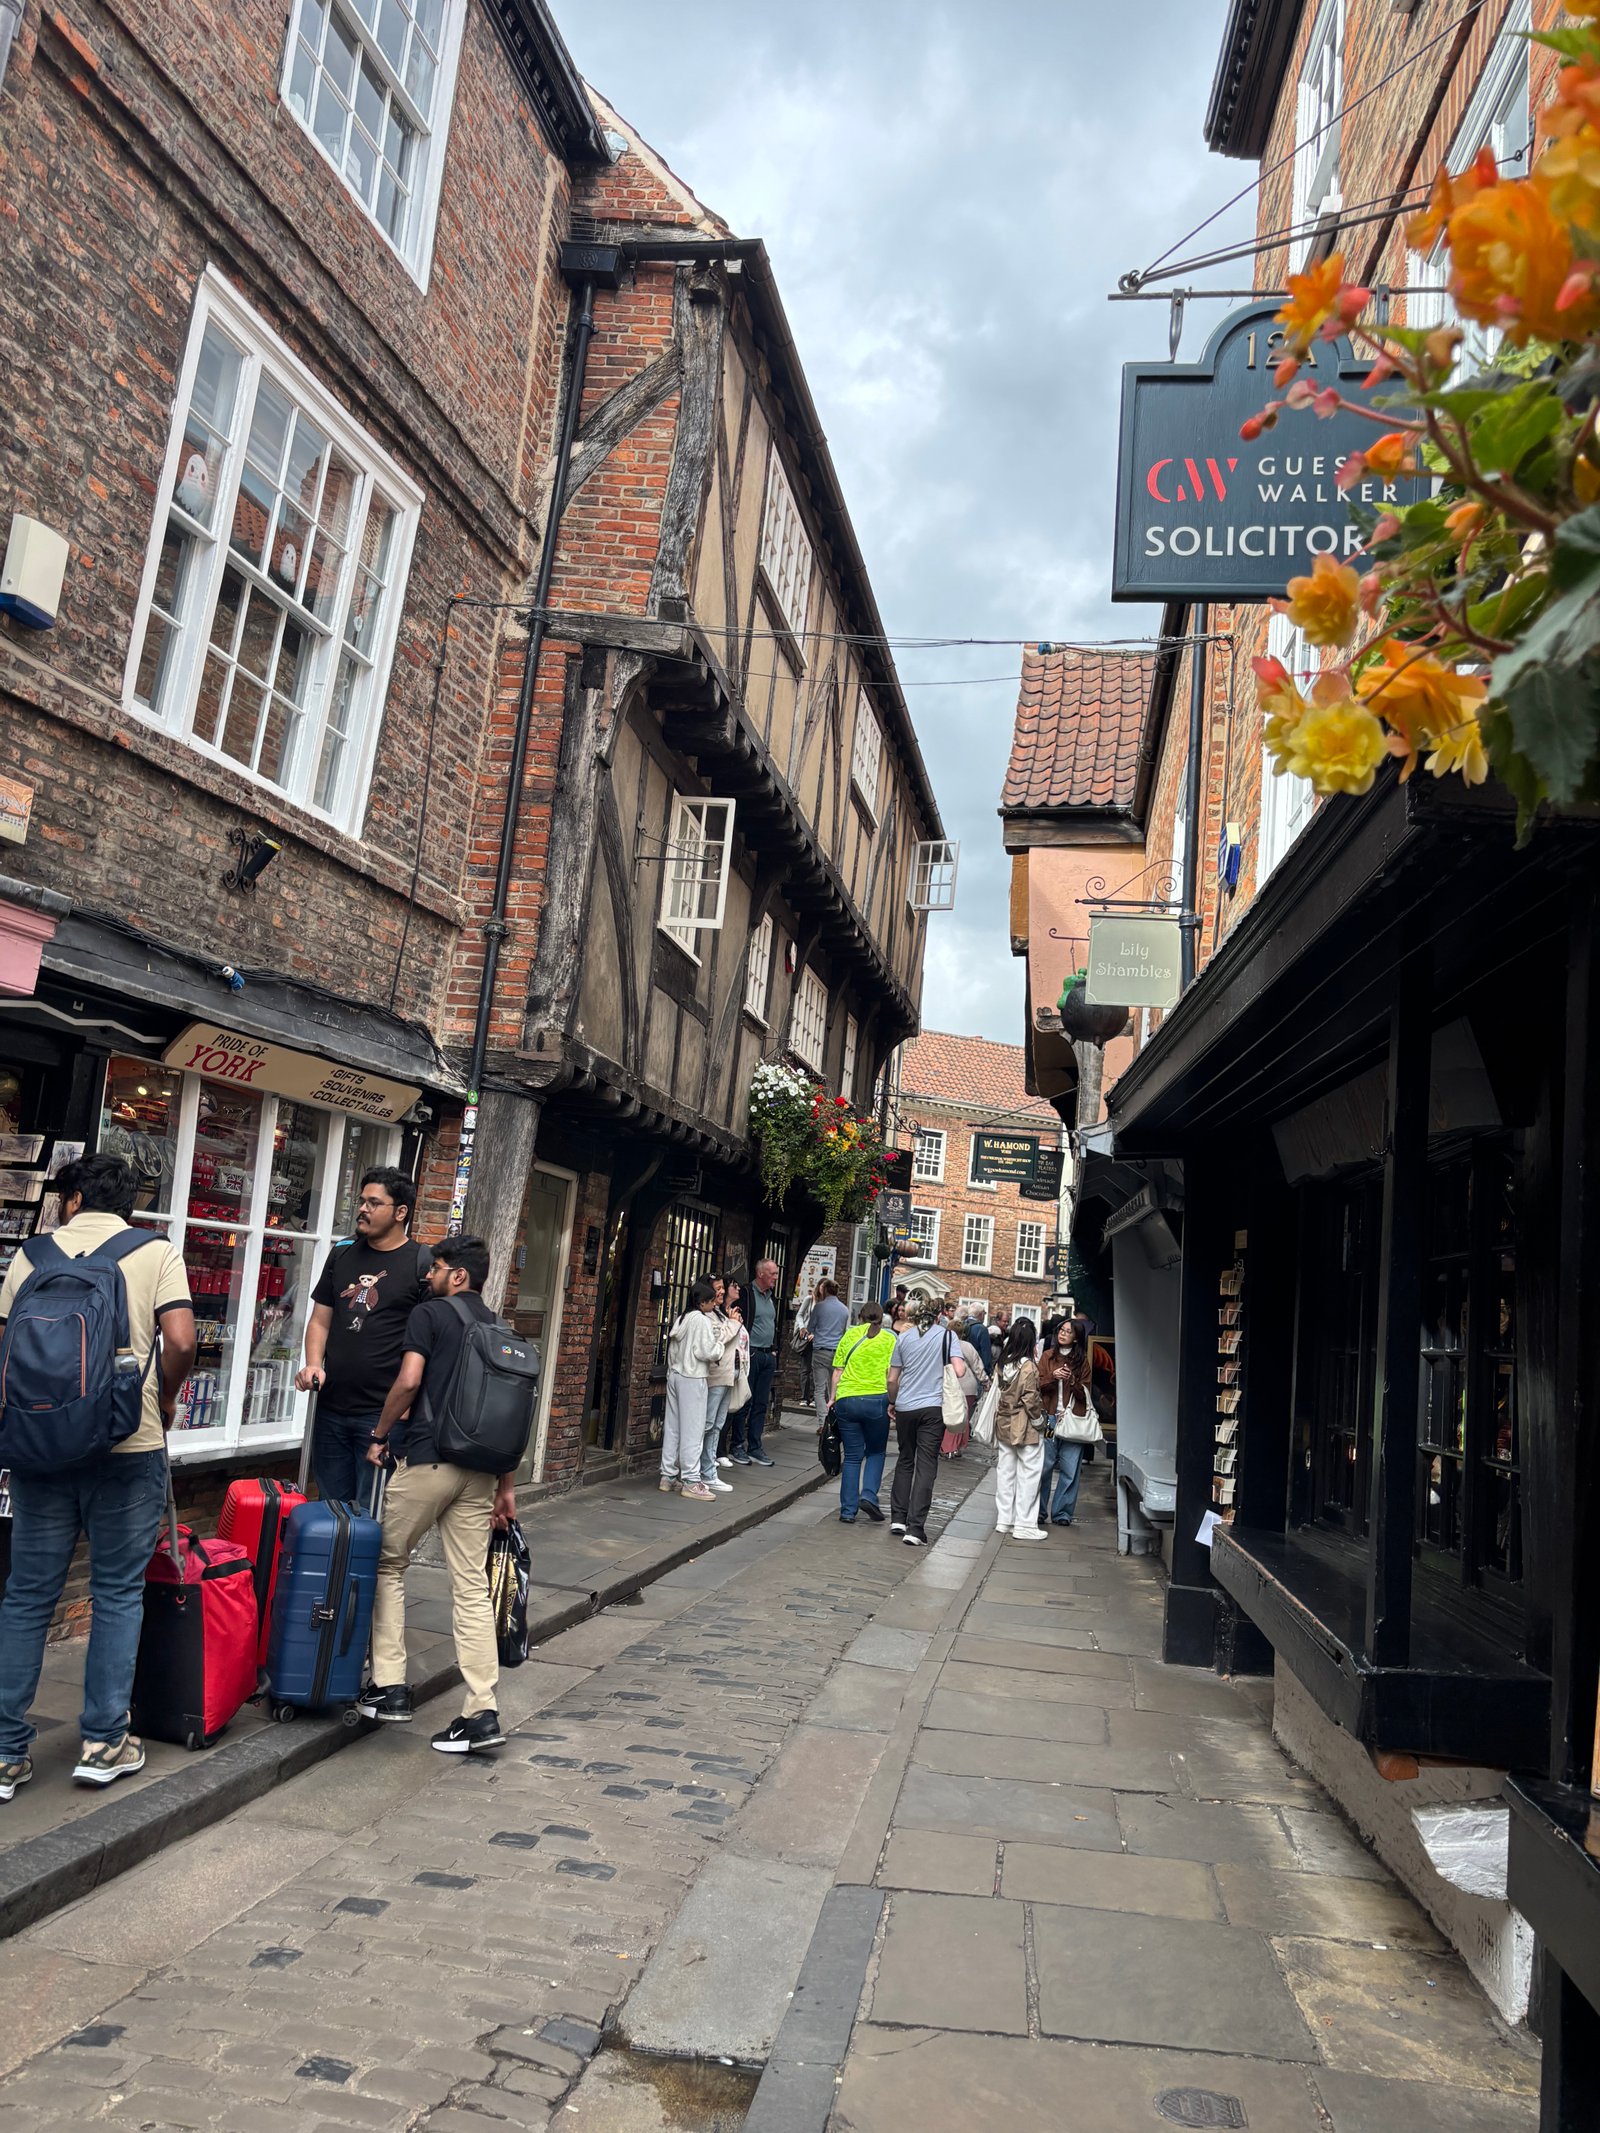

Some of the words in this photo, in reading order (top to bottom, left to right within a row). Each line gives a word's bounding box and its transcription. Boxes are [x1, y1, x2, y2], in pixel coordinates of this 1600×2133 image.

[1258, 457, 1348, 476] GUES
[1258, 483, 1398, 503] WALKER
[1145, 525, 1374, 557] SOLICITOR
[1120, 942, 1149, 960] Lily
[1096, 962, 1172, 979] Shambles
[211, 1033, 248, 1055] PRIDE
[249, 1044, 269, 1058] OF
[185, 1044, 266, 1083] YORK
[332, 1069, 366, 1085] GIFTS
[322, 1079, 386, 1104] SOUVENIRS
[312, 1090, 394, 1119] COLLECTABLES
[993, 1140, 1031, 1152] HAMOND
[1025, 1189, 1054, 1198] Chocolates
